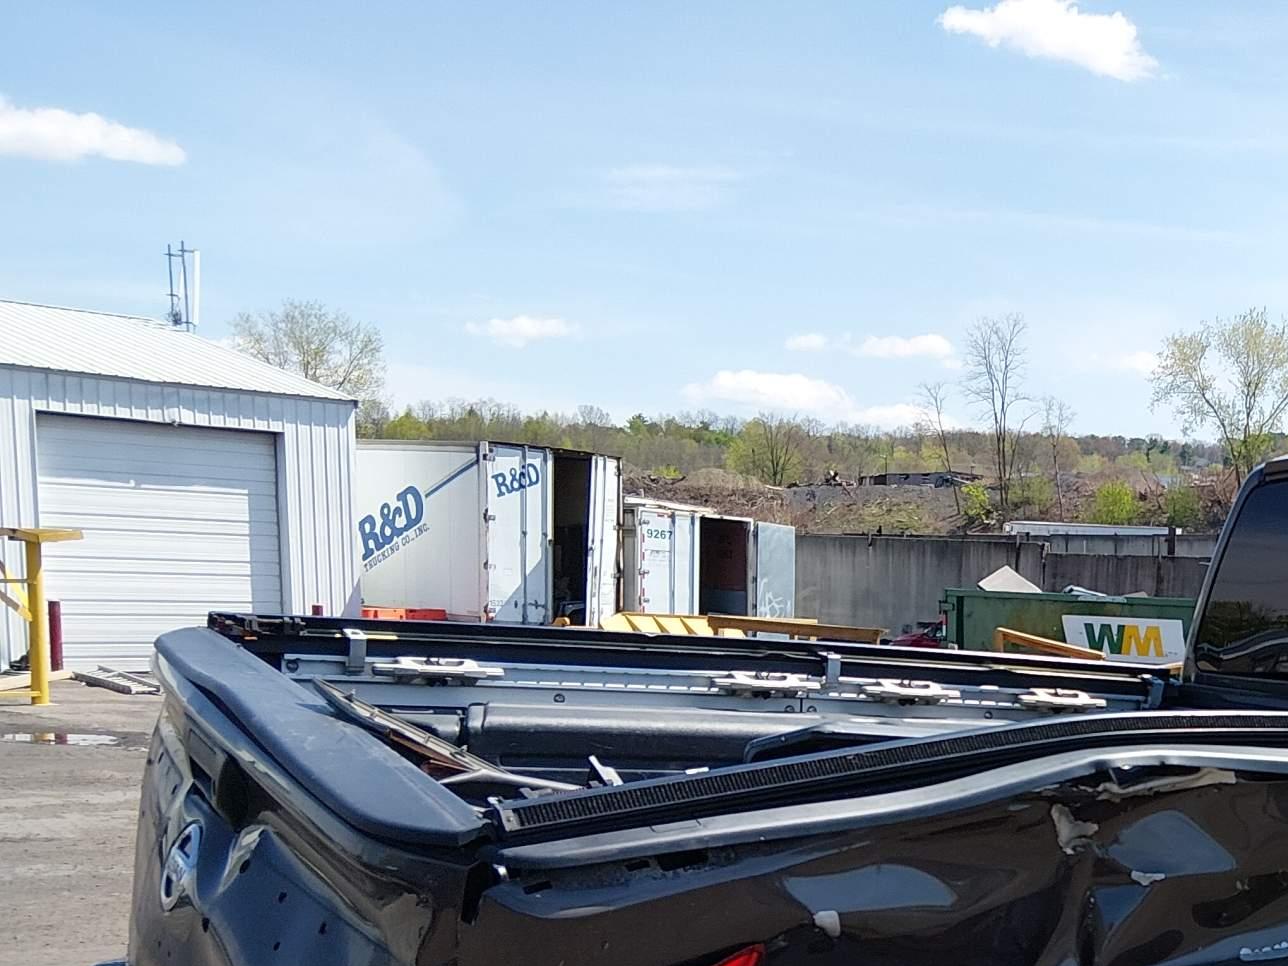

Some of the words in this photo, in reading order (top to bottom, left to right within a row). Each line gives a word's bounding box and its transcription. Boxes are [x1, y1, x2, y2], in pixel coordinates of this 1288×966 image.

[491, 463, 540, 498] R&D
[358, 485, 424, 562] R&D
[646, 528, 673, 540] 9267
[363, 541, 401, 573] TRUCKING
[1083, 622, 1165, 657] WM
